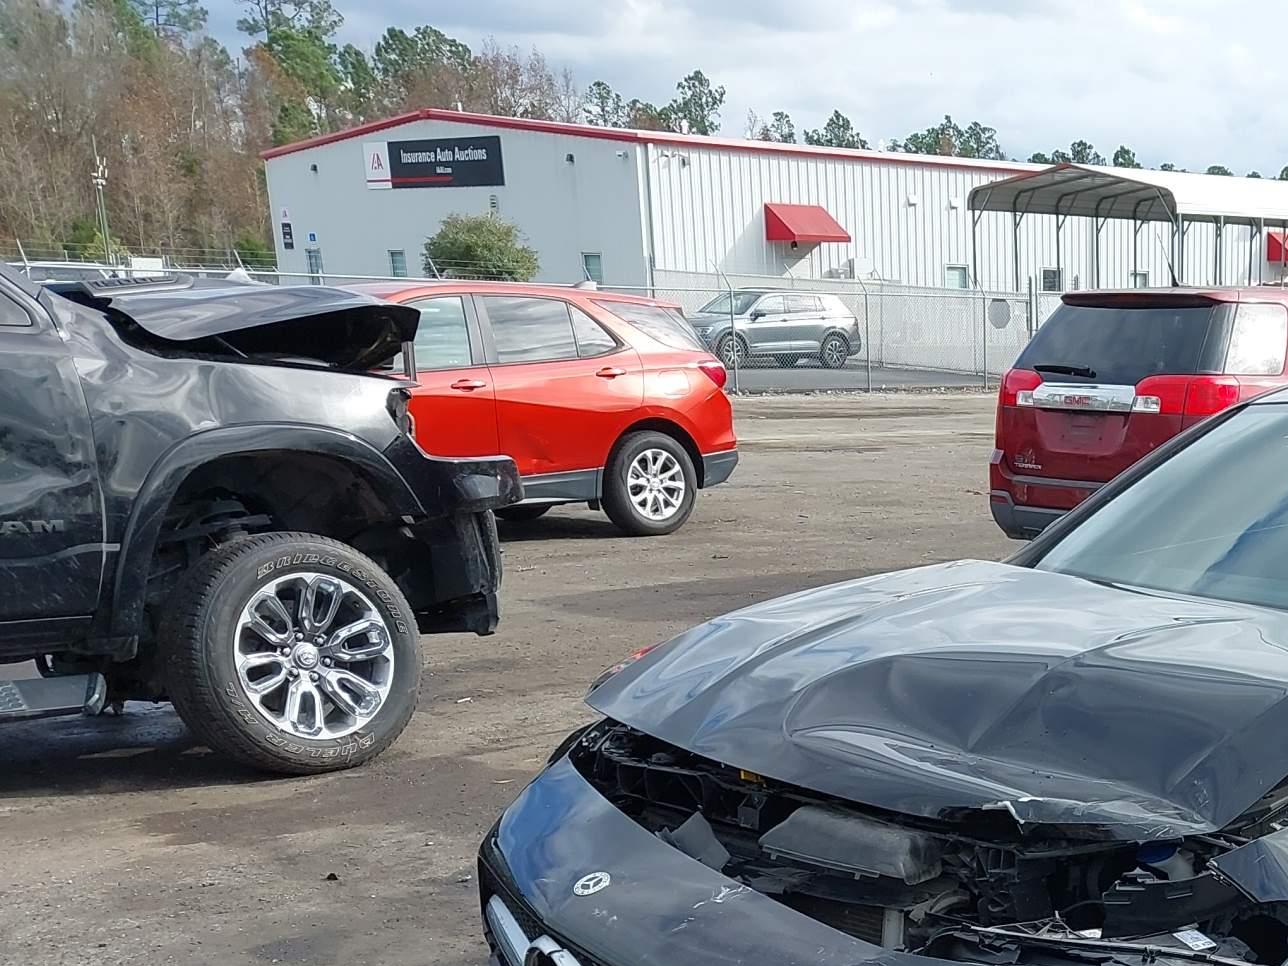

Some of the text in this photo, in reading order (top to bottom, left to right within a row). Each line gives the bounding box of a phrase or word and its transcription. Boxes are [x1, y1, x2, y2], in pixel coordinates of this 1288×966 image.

[400, 145, 487, 164] Insurance Auto Auctions
[1063, 395, 1090, 406] GMC
[0, 521, 64, 534] AM
[257, 552, 408, 635] BRIDGESTONE
[266, 732, 375, 758] DUELER
